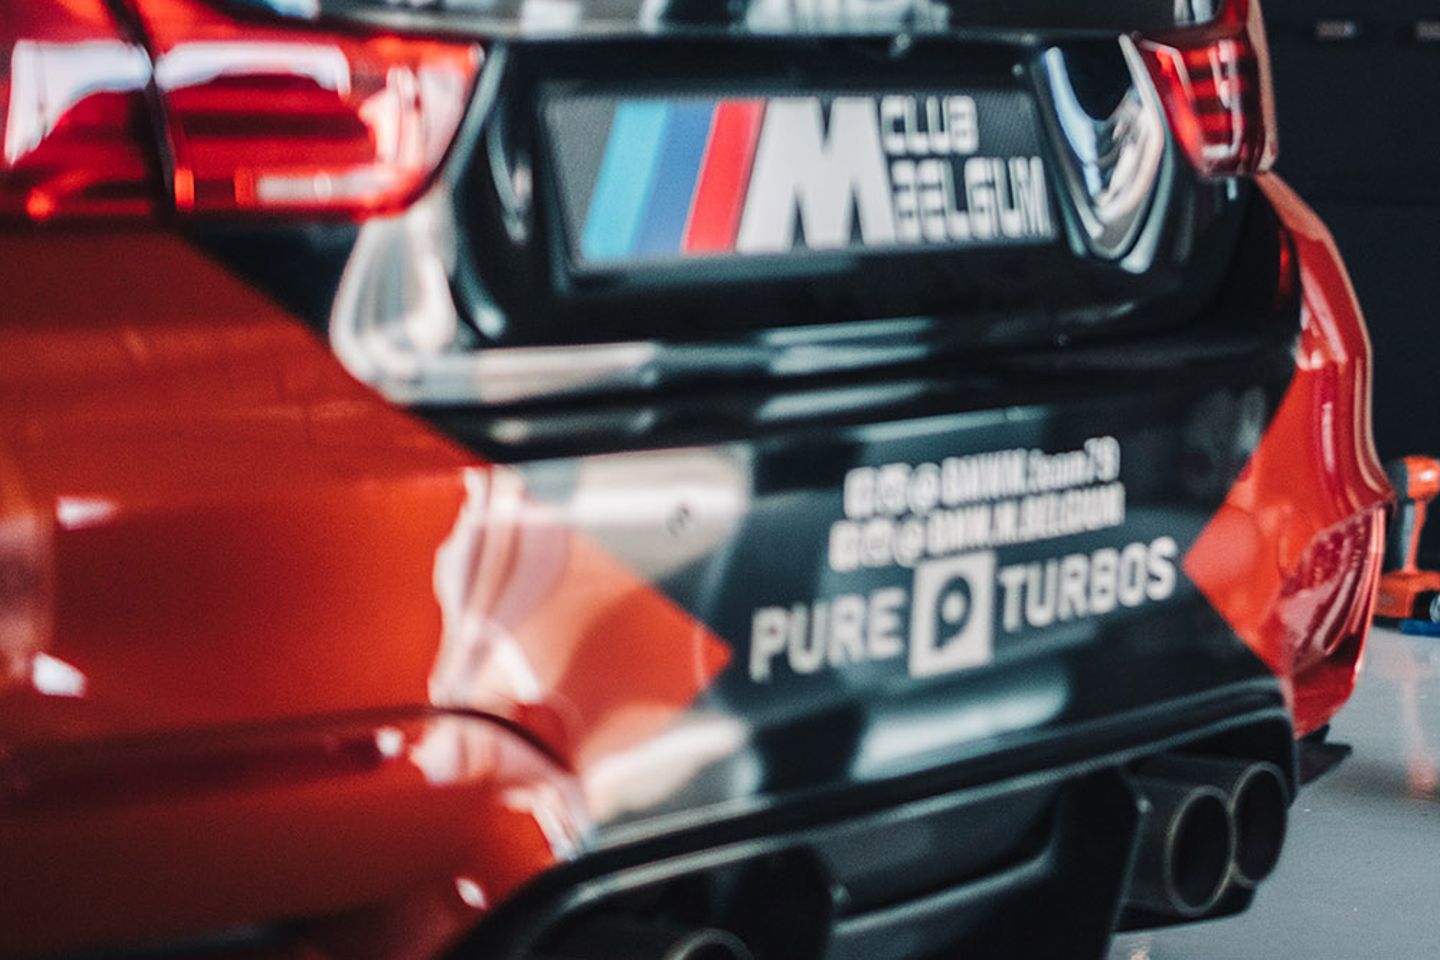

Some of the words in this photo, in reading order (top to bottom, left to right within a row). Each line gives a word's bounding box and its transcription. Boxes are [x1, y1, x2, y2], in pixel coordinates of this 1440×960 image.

[732, 95, 898, 253] M
[880, 95, 979, 155] CLUB
[749, 586, 907, 683] PURE
[998, 535, 1178, 633] TURBOS
